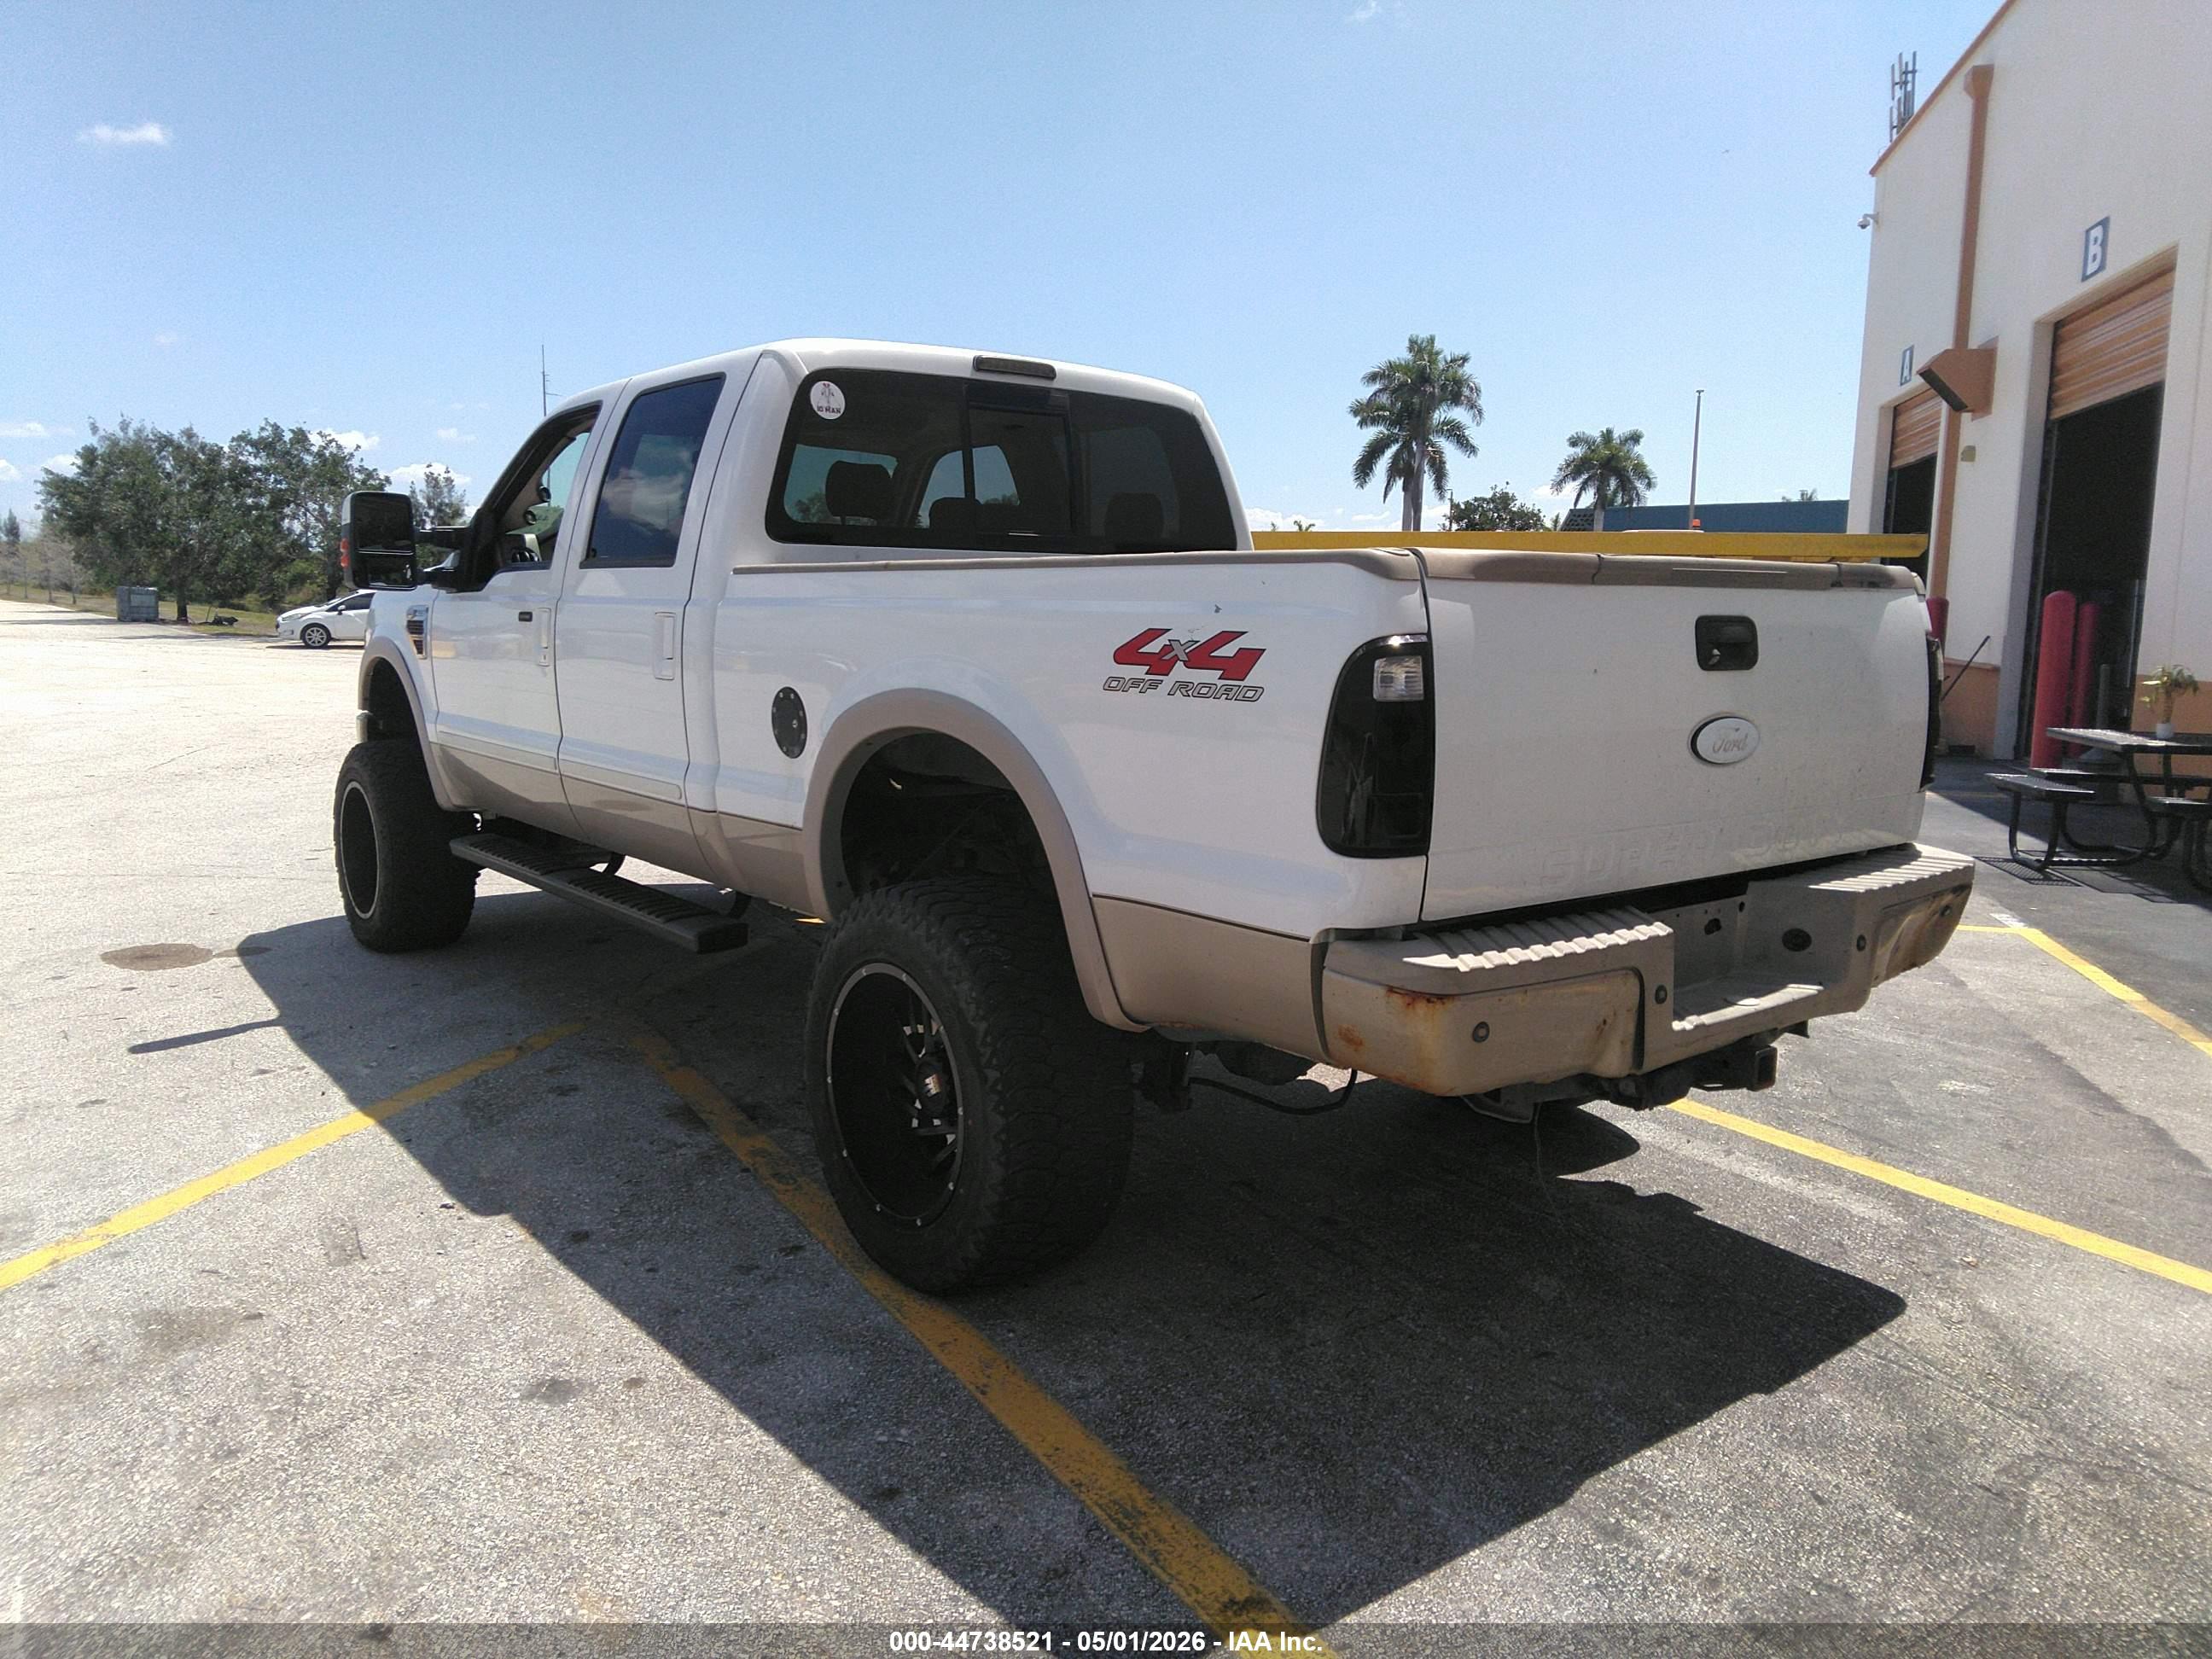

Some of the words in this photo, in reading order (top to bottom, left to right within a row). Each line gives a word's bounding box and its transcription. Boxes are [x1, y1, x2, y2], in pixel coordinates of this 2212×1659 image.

[2086, 224, 2104, 276] B
[1103, 676, 1164, 694] OFF
[1167, 680, 1265, 702] ROAD
[1712, 725, 1749, 754] Ford
